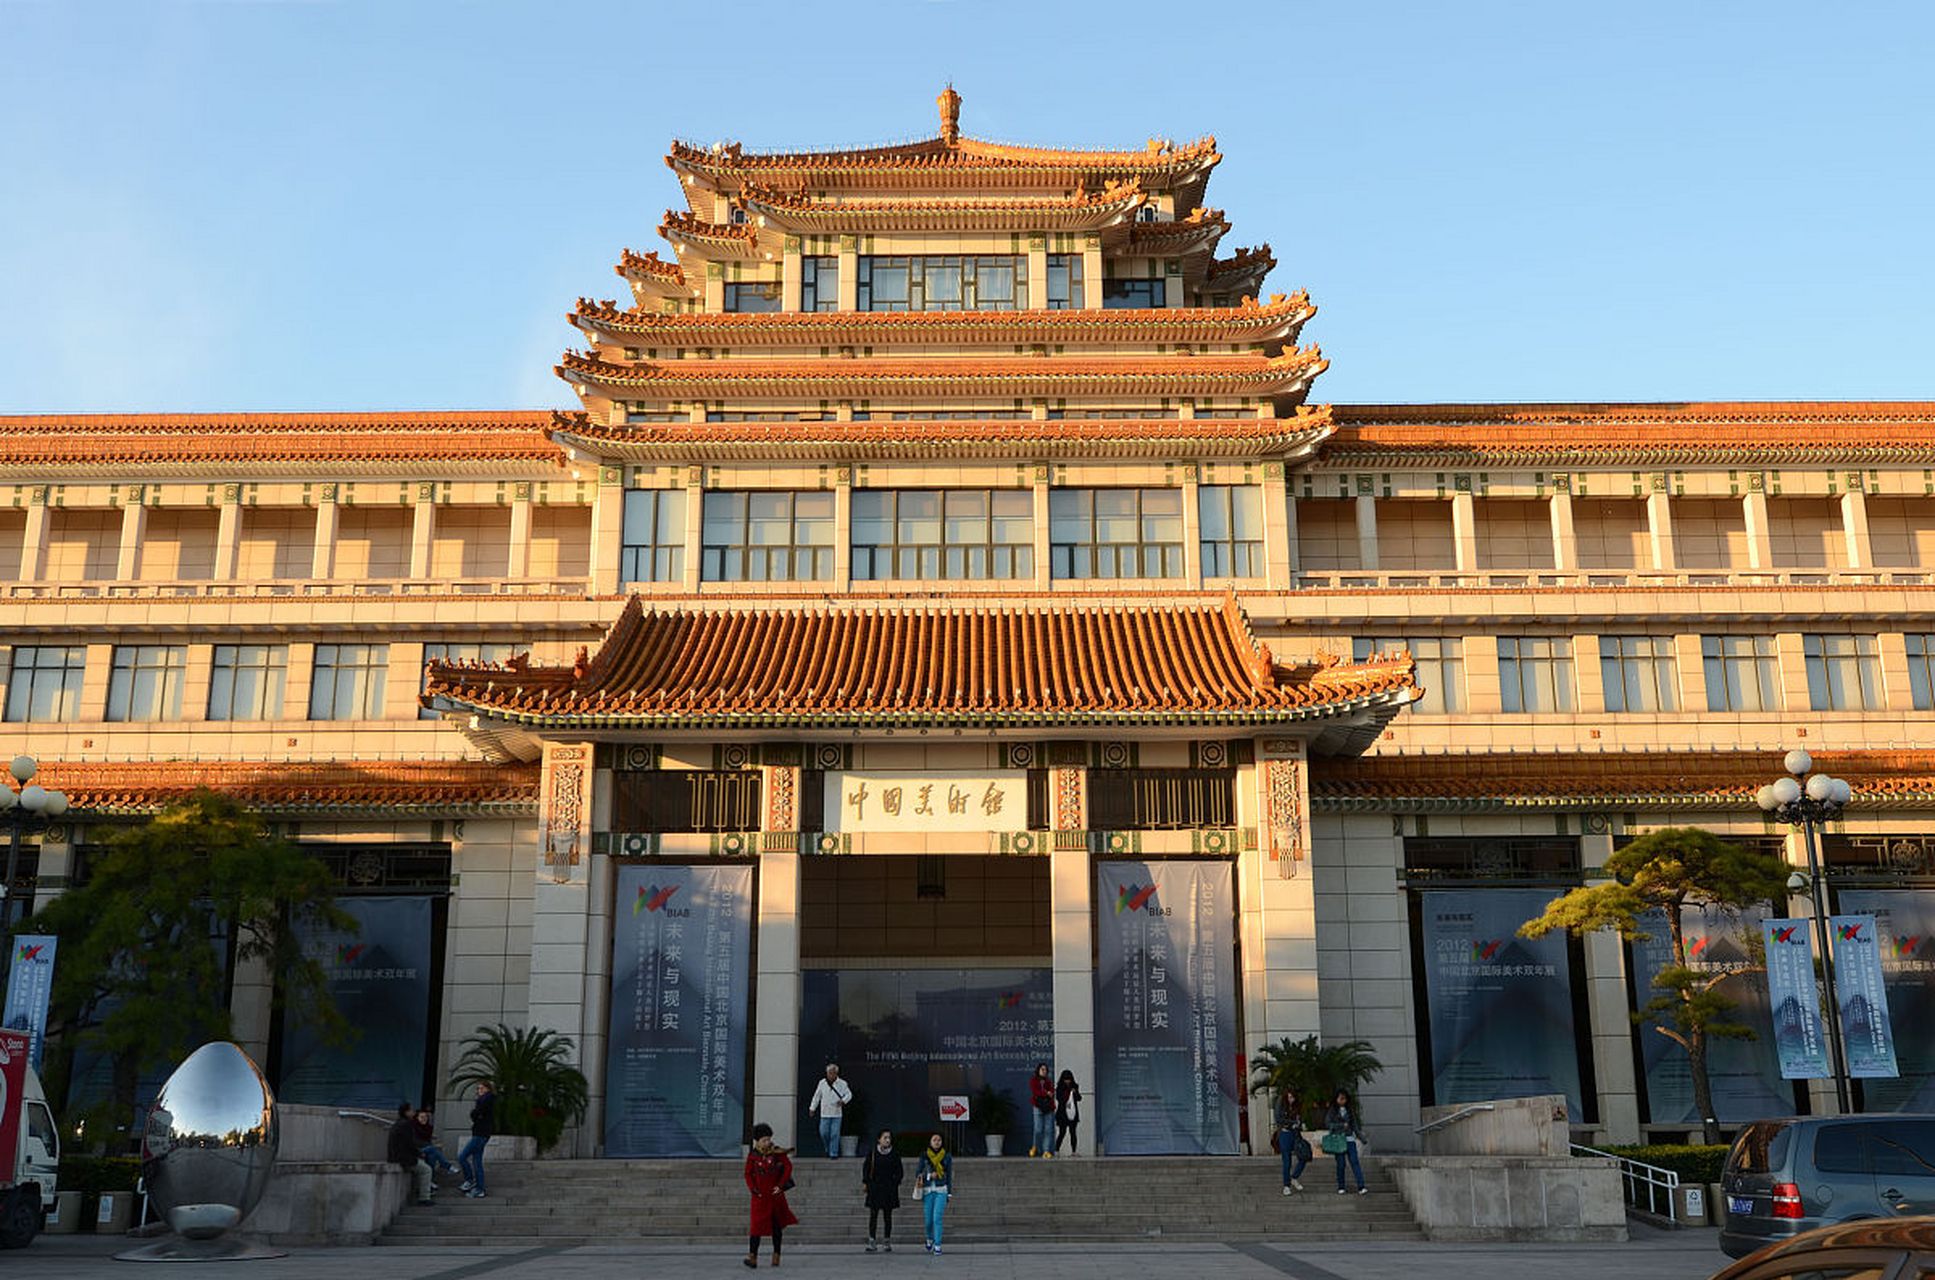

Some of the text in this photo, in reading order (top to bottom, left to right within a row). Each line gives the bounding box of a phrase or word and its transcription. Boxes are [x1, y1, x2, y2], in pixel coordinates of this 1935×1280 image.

[667, 908, 690, 917] BIAB
[1149, 907, 1171, 917] BIAB
[662, 923, 682, 1030] 未来与现实
[1150, 923, 1169, 1029] 未来与现实
